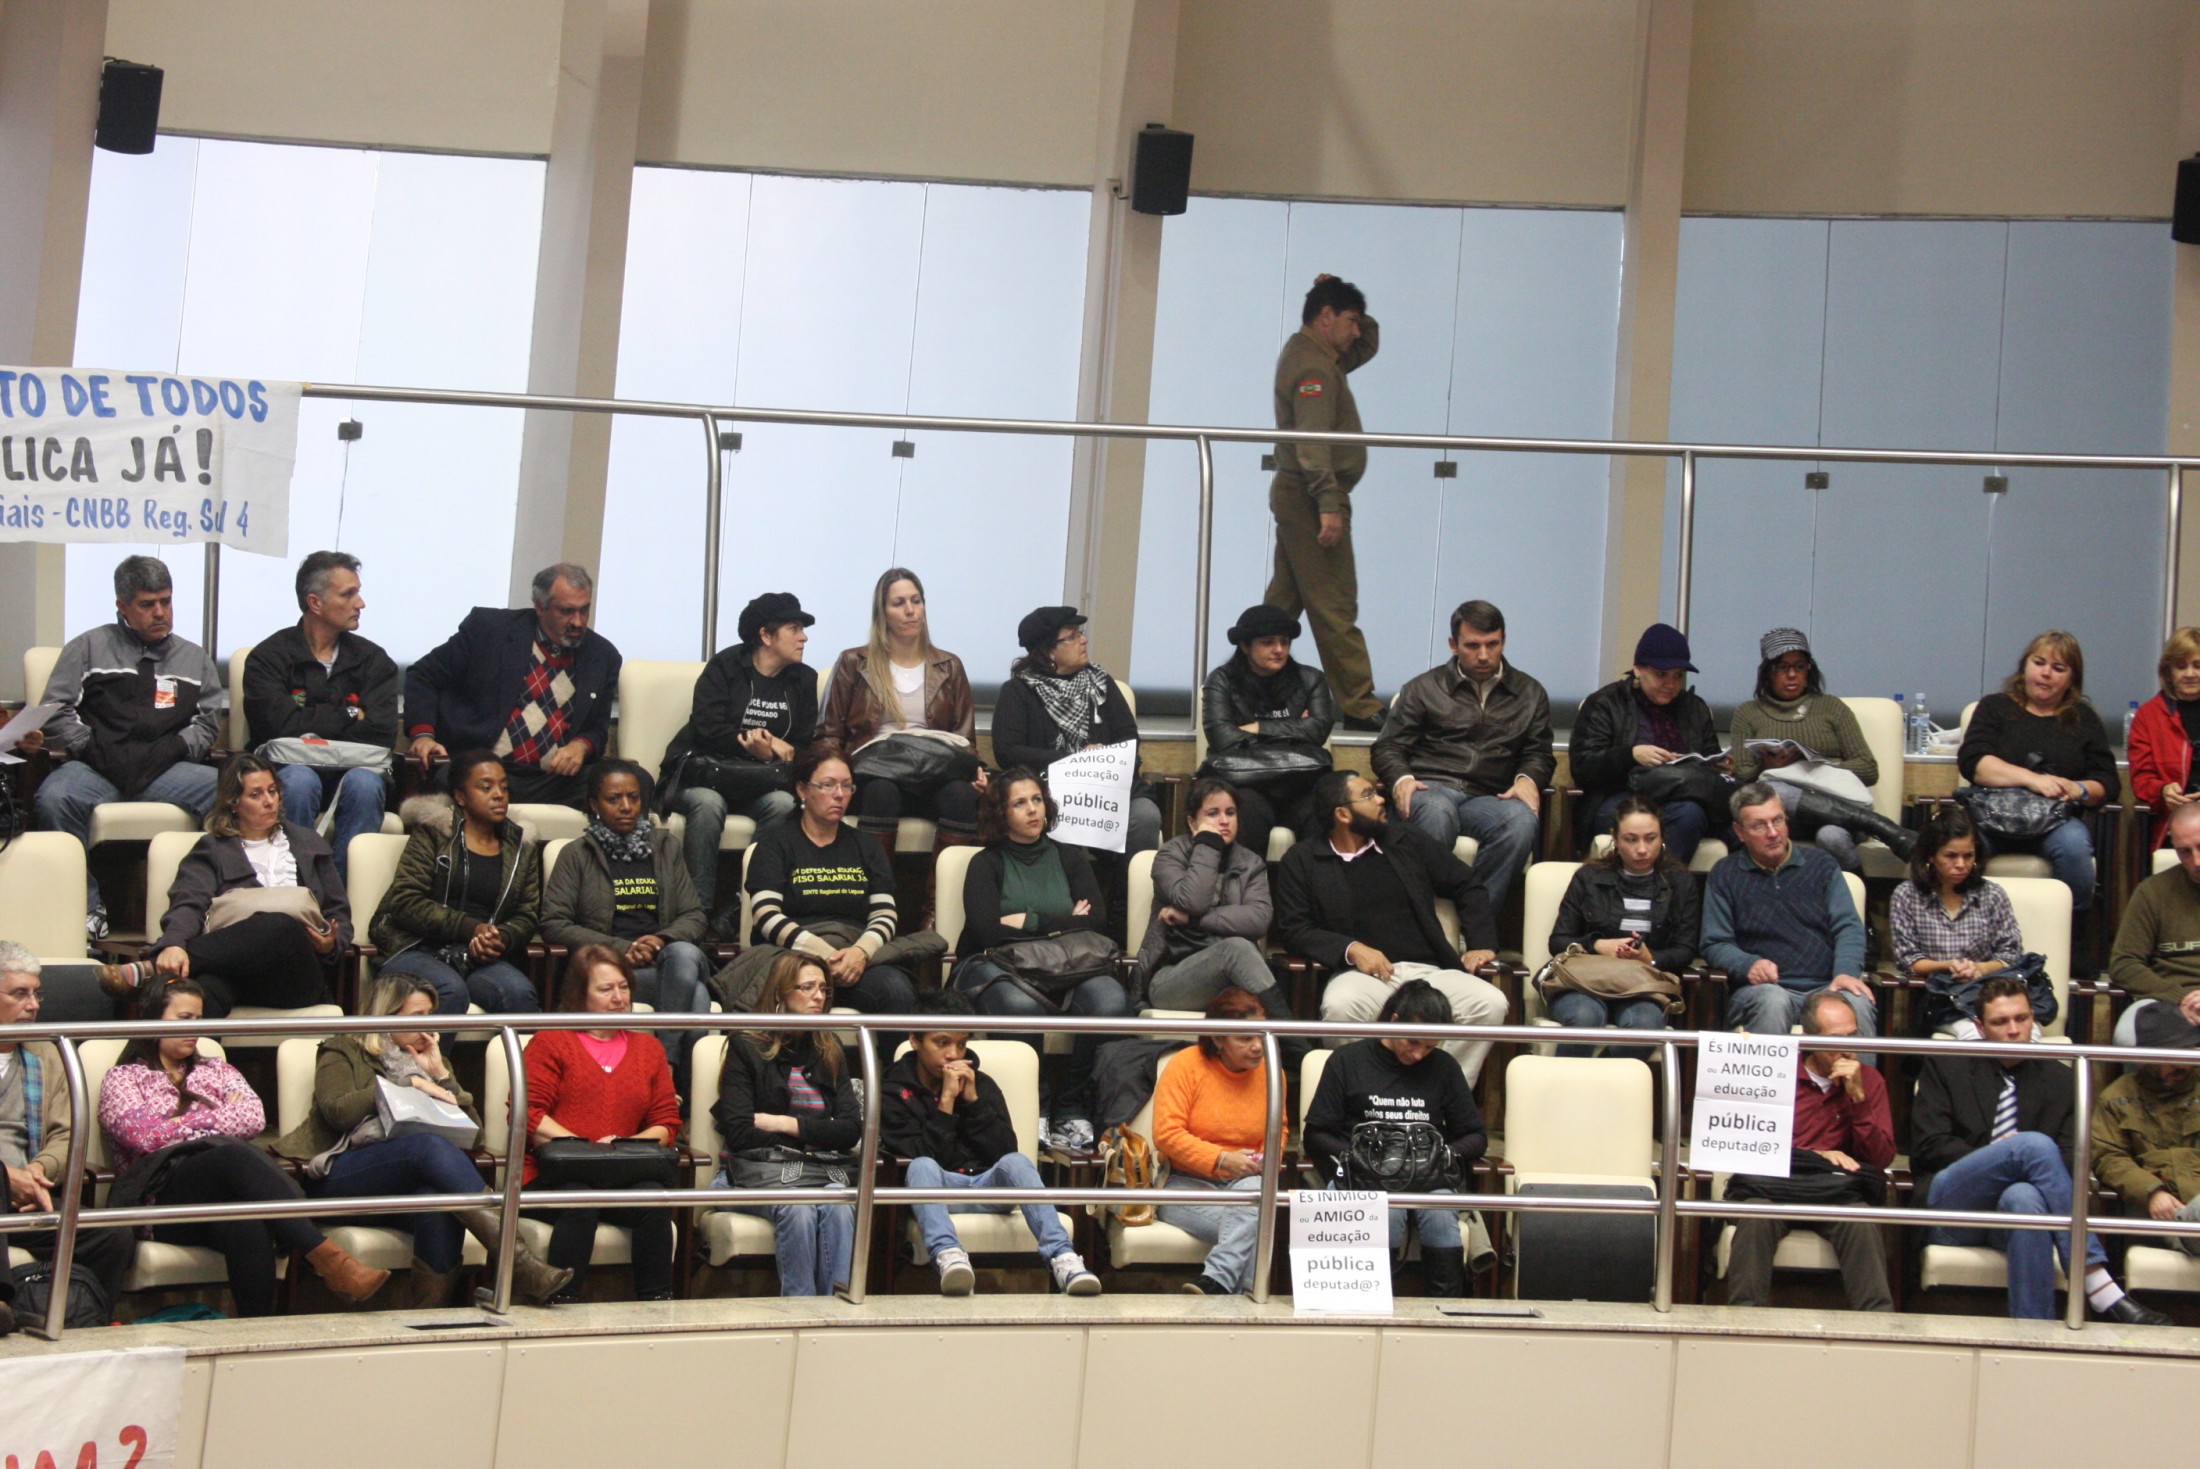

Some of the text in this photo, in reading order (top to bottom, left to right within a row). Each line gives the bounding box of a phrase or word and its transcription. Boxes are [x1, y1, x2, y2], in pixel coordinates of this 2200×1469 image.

[0, 370, 269, 423] TO DE TODOS
[1, 424, 213, 486] LICA JÁ!
[143, 499, 192, 538] Reg.
[236, 500, 249, 537] 4
[1069, 754, 1116, 764] AMIGO
[1065, 769, 1119, 782] educação
[1063, 792, 1119, 813] pública
[1057, 812, 1120, 832] deputad@?
[793, 874, 815, 884] PISO
[817, 873, 856, 882] SALARIAL
[614, 886, 655, 896] SALARIAL
[1708, 1038, 1789, 1058] És INIMIGO
[1721, 1063, 1773, 1078] AMIGO
[1777, 1071, 1786, 1079] da
[1714, 1083, 1777, 1099] educação
[1396, 1096, 1410, 1107] não
[1411, 1097, 1425, 1108] luta
[1364, 1108, 1430, 1121] pelos seus direitos
[1708, 1112, 1777, 1133] pública
[1701, 1137, 1780, 1155] deputad@?
[1318, 1191, 1378, 1202] INIMIGO
[1313, 1210, 1365, 1223] AMIGO
[1308, 1230, 1370, 1244] educação
[1307, 1256, 1375, 1273] pública
[1303, 1279, 1380, 1292] deputad@?
